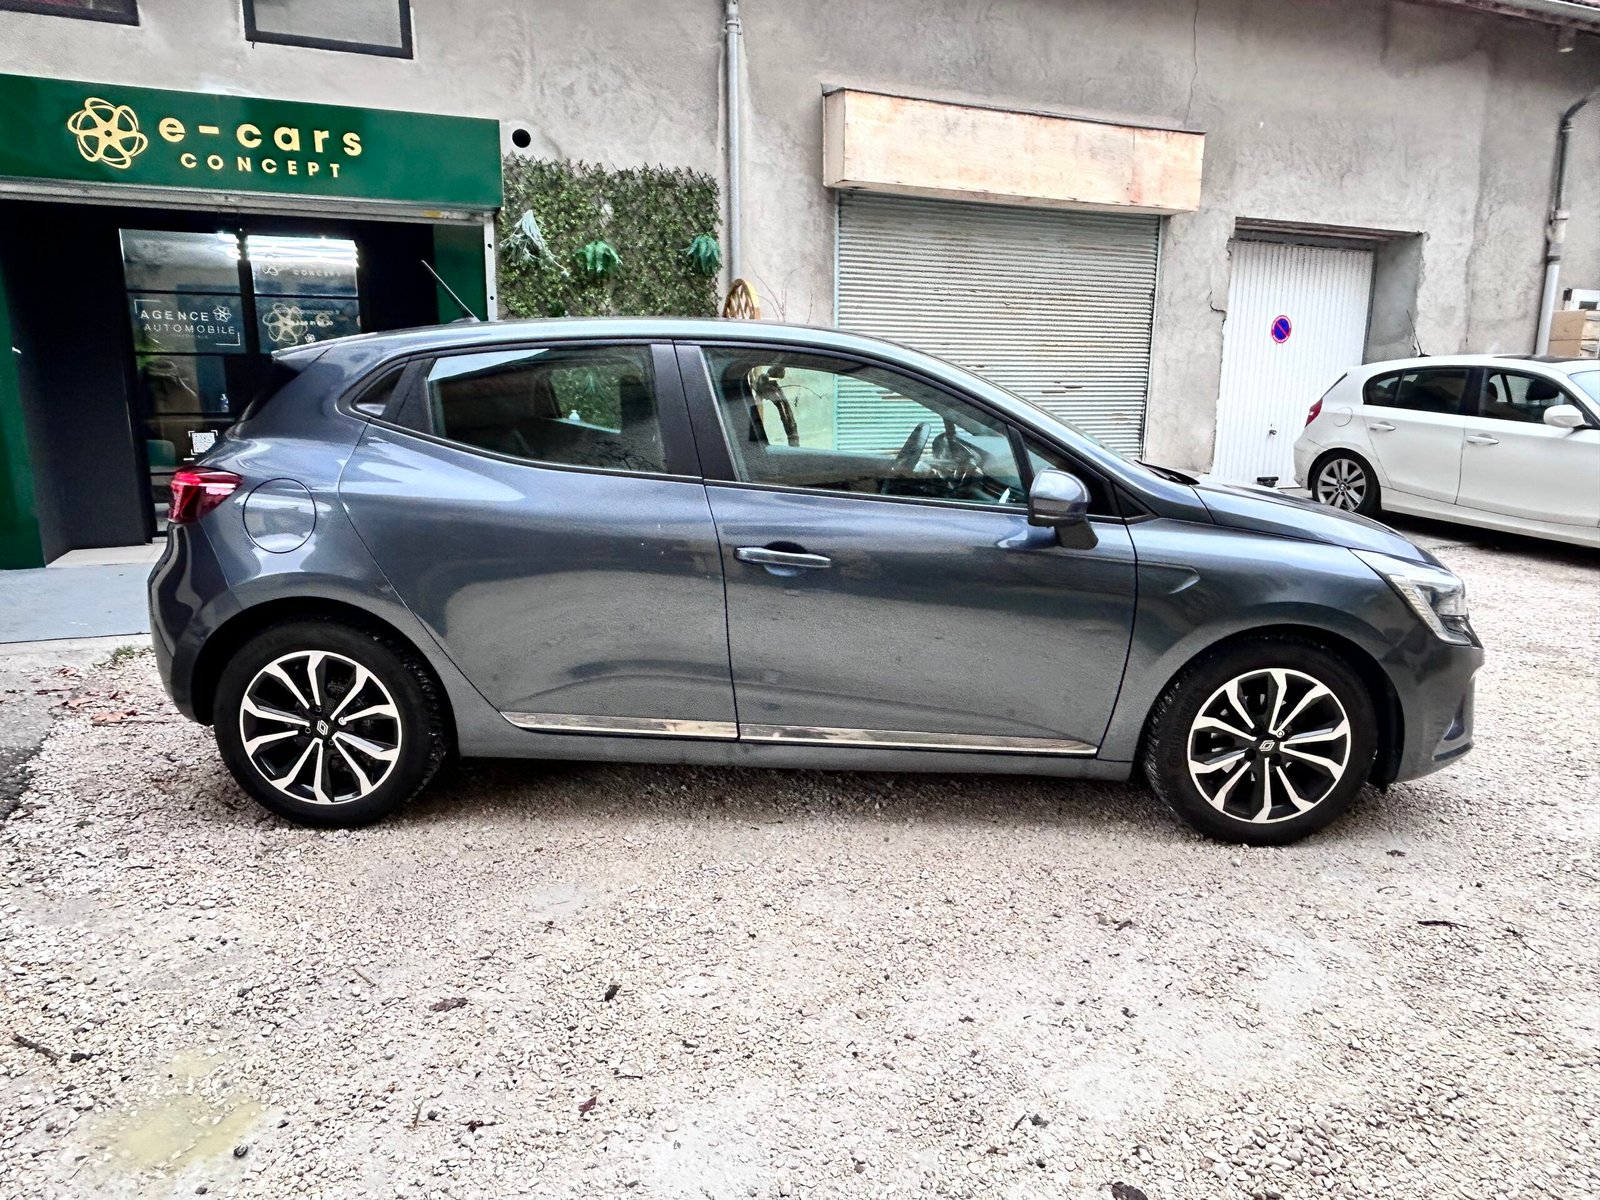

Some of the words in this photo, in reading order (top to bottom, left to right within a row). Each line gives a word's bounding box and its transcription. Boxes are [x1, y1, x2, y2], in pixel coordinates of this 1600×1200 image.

[180, 152, 341, 178] CONCEPT
[140, 309, 210, 322] AGENCE
[143, 323, 236, 335] AUTOMOBILE
